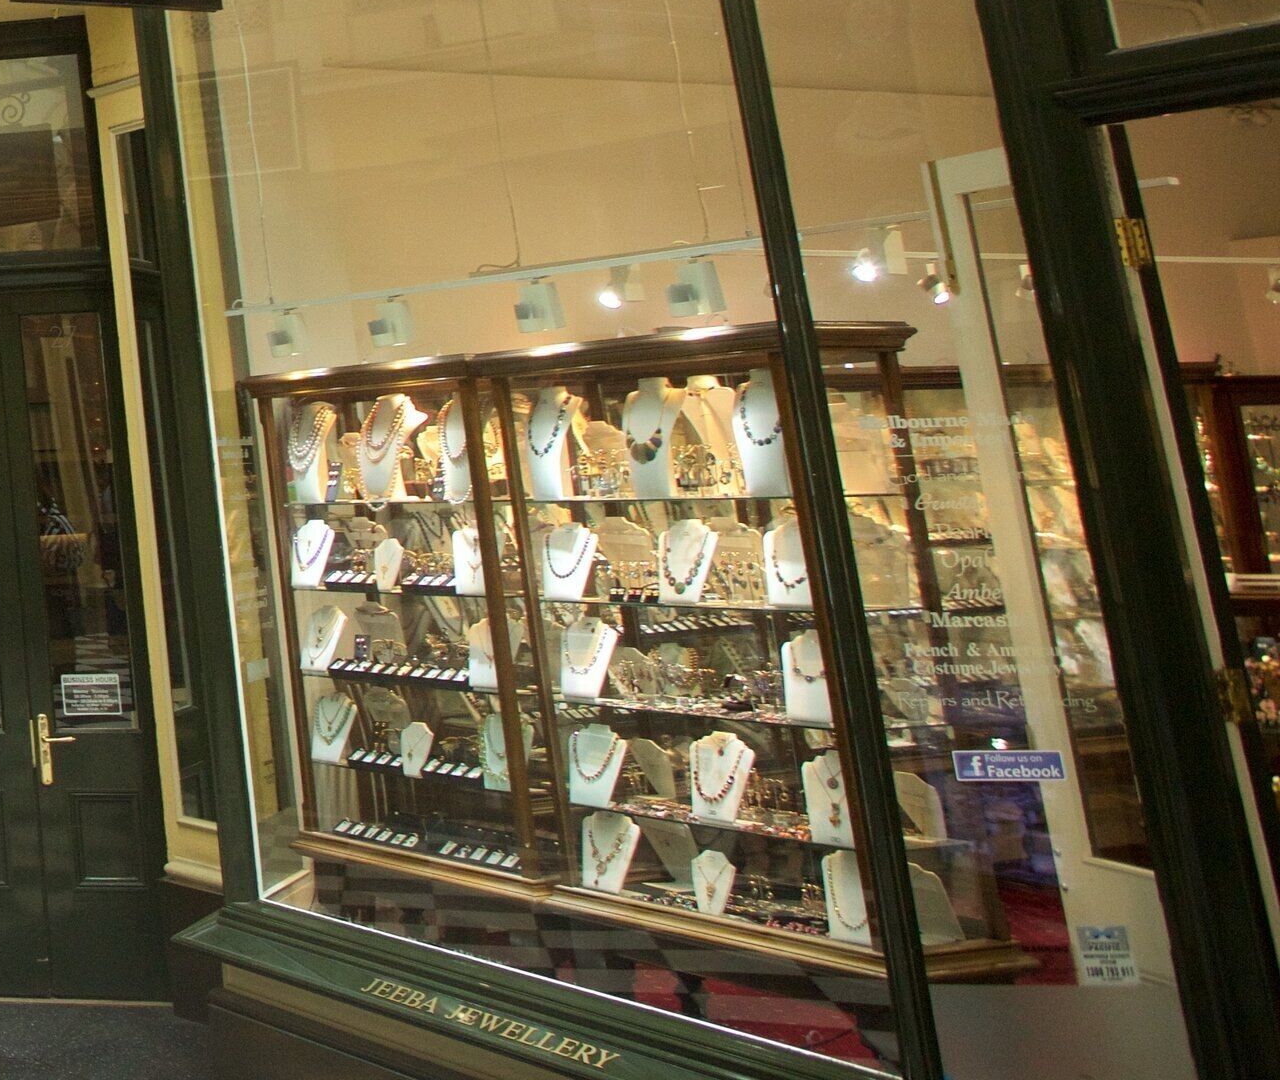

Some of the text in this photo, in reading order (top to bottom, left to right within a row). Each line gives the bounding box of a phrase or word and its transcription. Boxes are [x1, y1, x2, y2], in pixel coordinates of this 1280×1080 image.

[904, 642, 958, 657] French
[984, 754, 1015, 762] Follow
[987, 764, 1061, 777] Facebook
[361, 977, 620, 1069] JEEBA JEWELLERY
